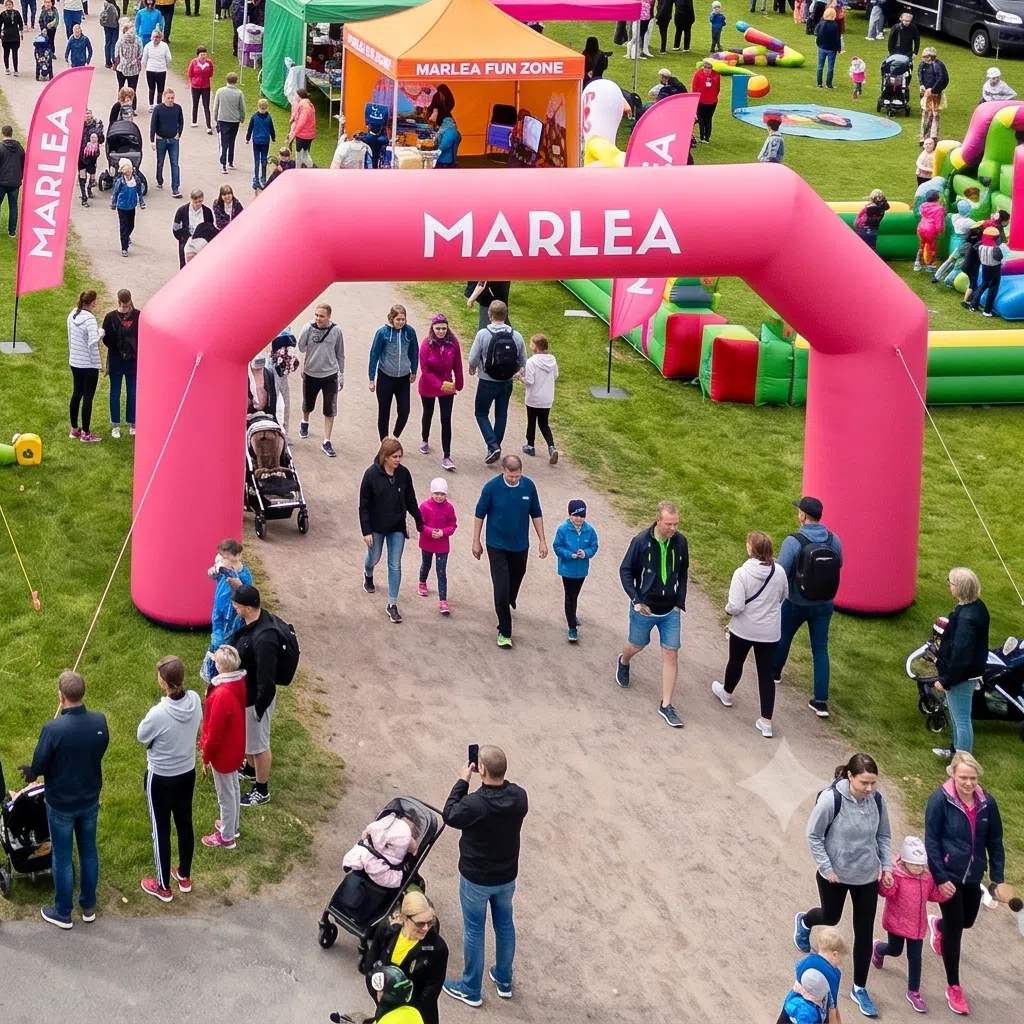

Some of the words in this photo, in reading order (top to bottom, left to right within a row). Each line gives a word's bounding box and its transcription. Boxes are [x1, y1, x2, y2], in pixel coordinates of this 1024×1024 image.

[416, 63, 481, 76] MARLEA
[485, 62, 517, 75] FUN
[520, 61, 563, 75] ZONE
[28, 106, 73, 258] MARLEA
[423, 208, 682, 258] MARLEA
